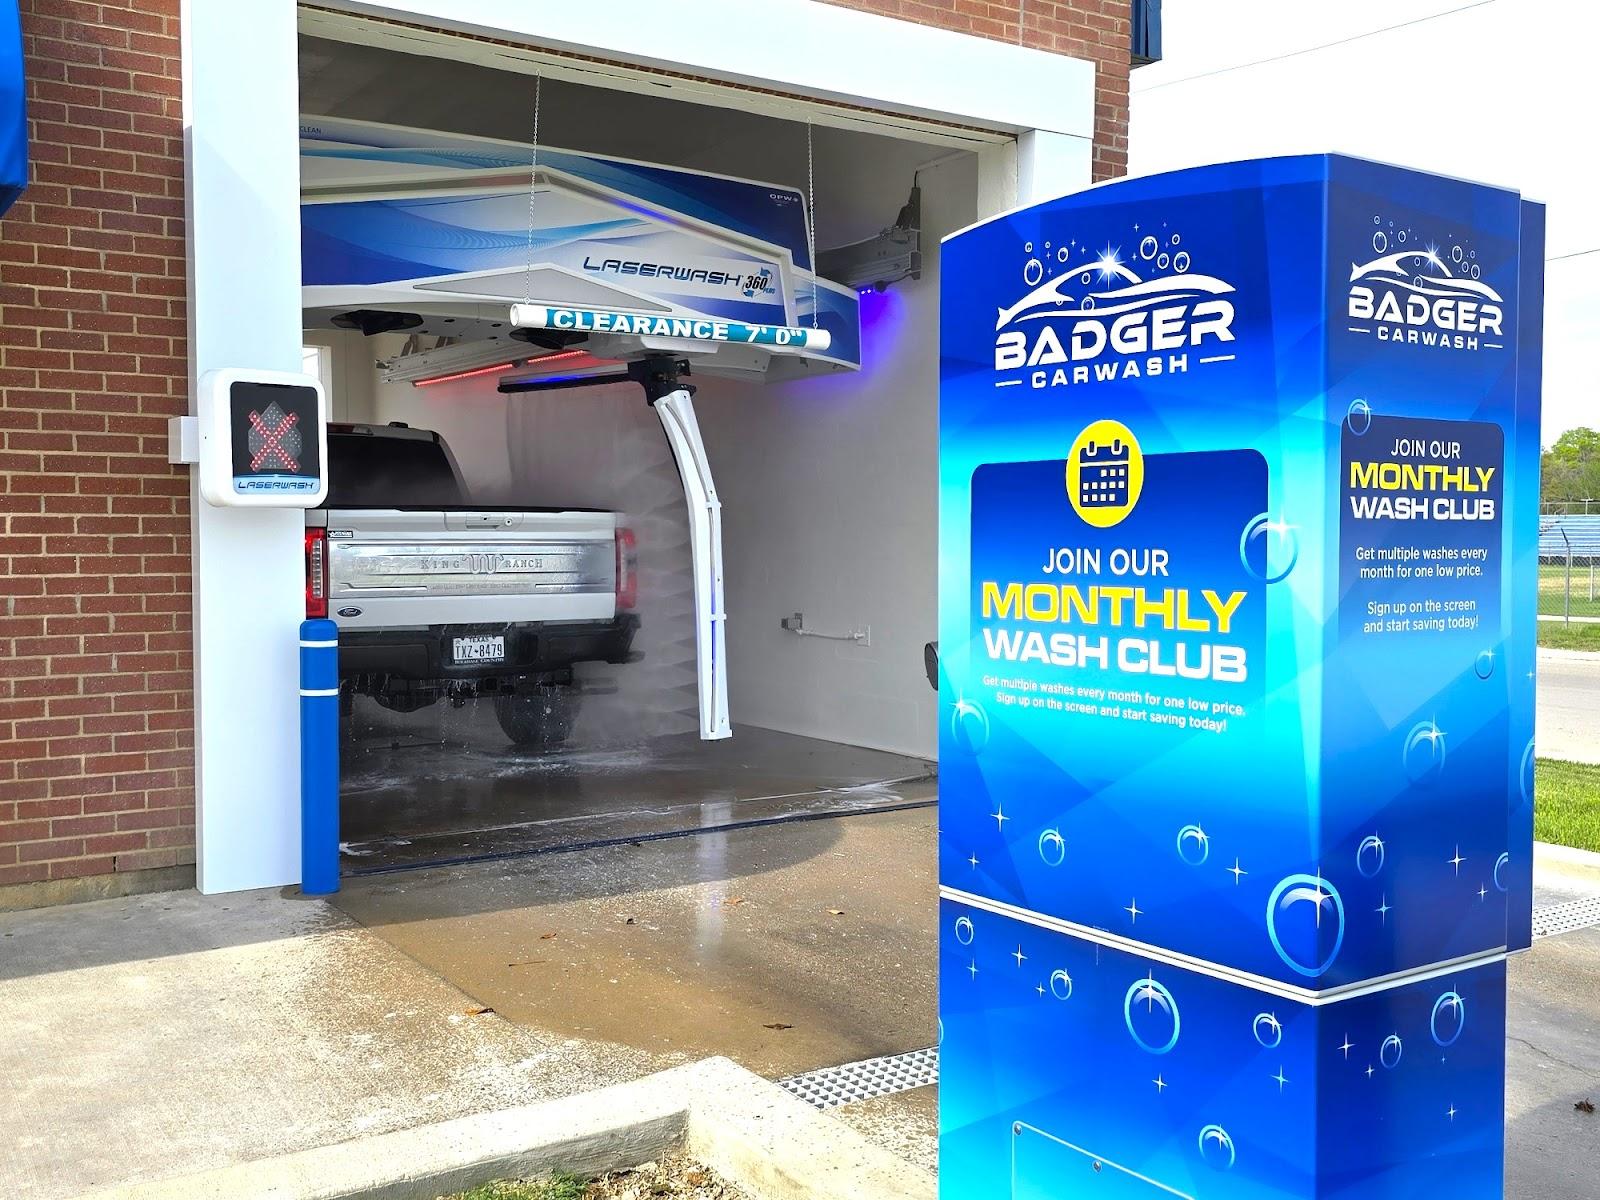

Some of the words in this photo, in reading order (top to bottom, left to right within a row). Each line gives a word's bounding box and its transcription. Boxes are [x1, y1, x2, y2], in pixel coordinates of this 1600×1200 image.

[583, 256, 741, 286] LASERWASH
[745, 275, 768, 290] 360
[1348, 286, 1503, 336] BADGER
[552, 310, 729, 341] CLEARANCE
[744, 325, 768, 343] 7'
[995, 300, 1236, 371] BADGER
[1377, 326, 1478, 350] CARWASH
[1031, 353, 1188, 389] CARWASH
[1390, 438, 1426, 458] JOIN
[1429, 441, 1461, 459] OUR
[238, 481, 315, 489] LASERWASH
[1350, 461, 1496, 492] MONTHLY
[1350, 496, 1429, 520] WASH
[1433, 499, 1495, 521] CLUB
[420, 559, 460, 569] KING
[505, 558, 543, 568] RANCH
[1042, 548, 1100, 575] JOIN
[1109, 548, 1169, 576] OUR
[1356, 547, 1375, 560] Get
[1378, 546, 1419, 563] multiple
[1422, 547, 1458, 560] washes
[1461, 548, 1488, 561] every
[1360, 565, 1394, 578] month
[1397, 564, 1412, 578] for
[1415, 566, 1433, 577] one
[1436, 564, 1453, 577] low
[1456, 563, 1483, 579] price.
[982, 581, 1248, 633] MONTHLY
[1367, 601, 1390, 617] Sign
[1393, 602, 1407, 616] up
[1409, 602, 1422, 613] on
[1425, 599, 1441, 612] the
[1444, 599, 1475, 611] screen
[1364, 619, 1384, 633] and
[1386, 618, 1409, 632] start
[1413, 617, 1445, 632] saving
[1447, 615, 1479, 630] today!
[983, 628, 1108, 670] WASH
[1117, 637, 1247, 683] CLUB
[983, 675, 999, 686] Get
[1001, 678, 1037, 692] multiple
[1040, 683, 1074, 696] washes
[1077, 687, 1105, 701] every
[1108, 690, 1142, 703] month
[1145, 692, 1161, 705] for
[1164, 696, 1185, 708] one
[1188, 697, 1209, 711] low
[1212, 701, 1246, 716] price.
[996, 692, 1016, 705] Sign
[1018, 696, 1030, 707] up
[1032, 698, 1045, 708] on
[1047, 698, 1062, 710] the
[1065, 702, 1097, 714] screen
[1100, 705, 1120, 718] and
[1122, 708, 1147, 721] start
[1150, 712, 1187, 729] saving
[1189, 715, 1227, 734] today!
